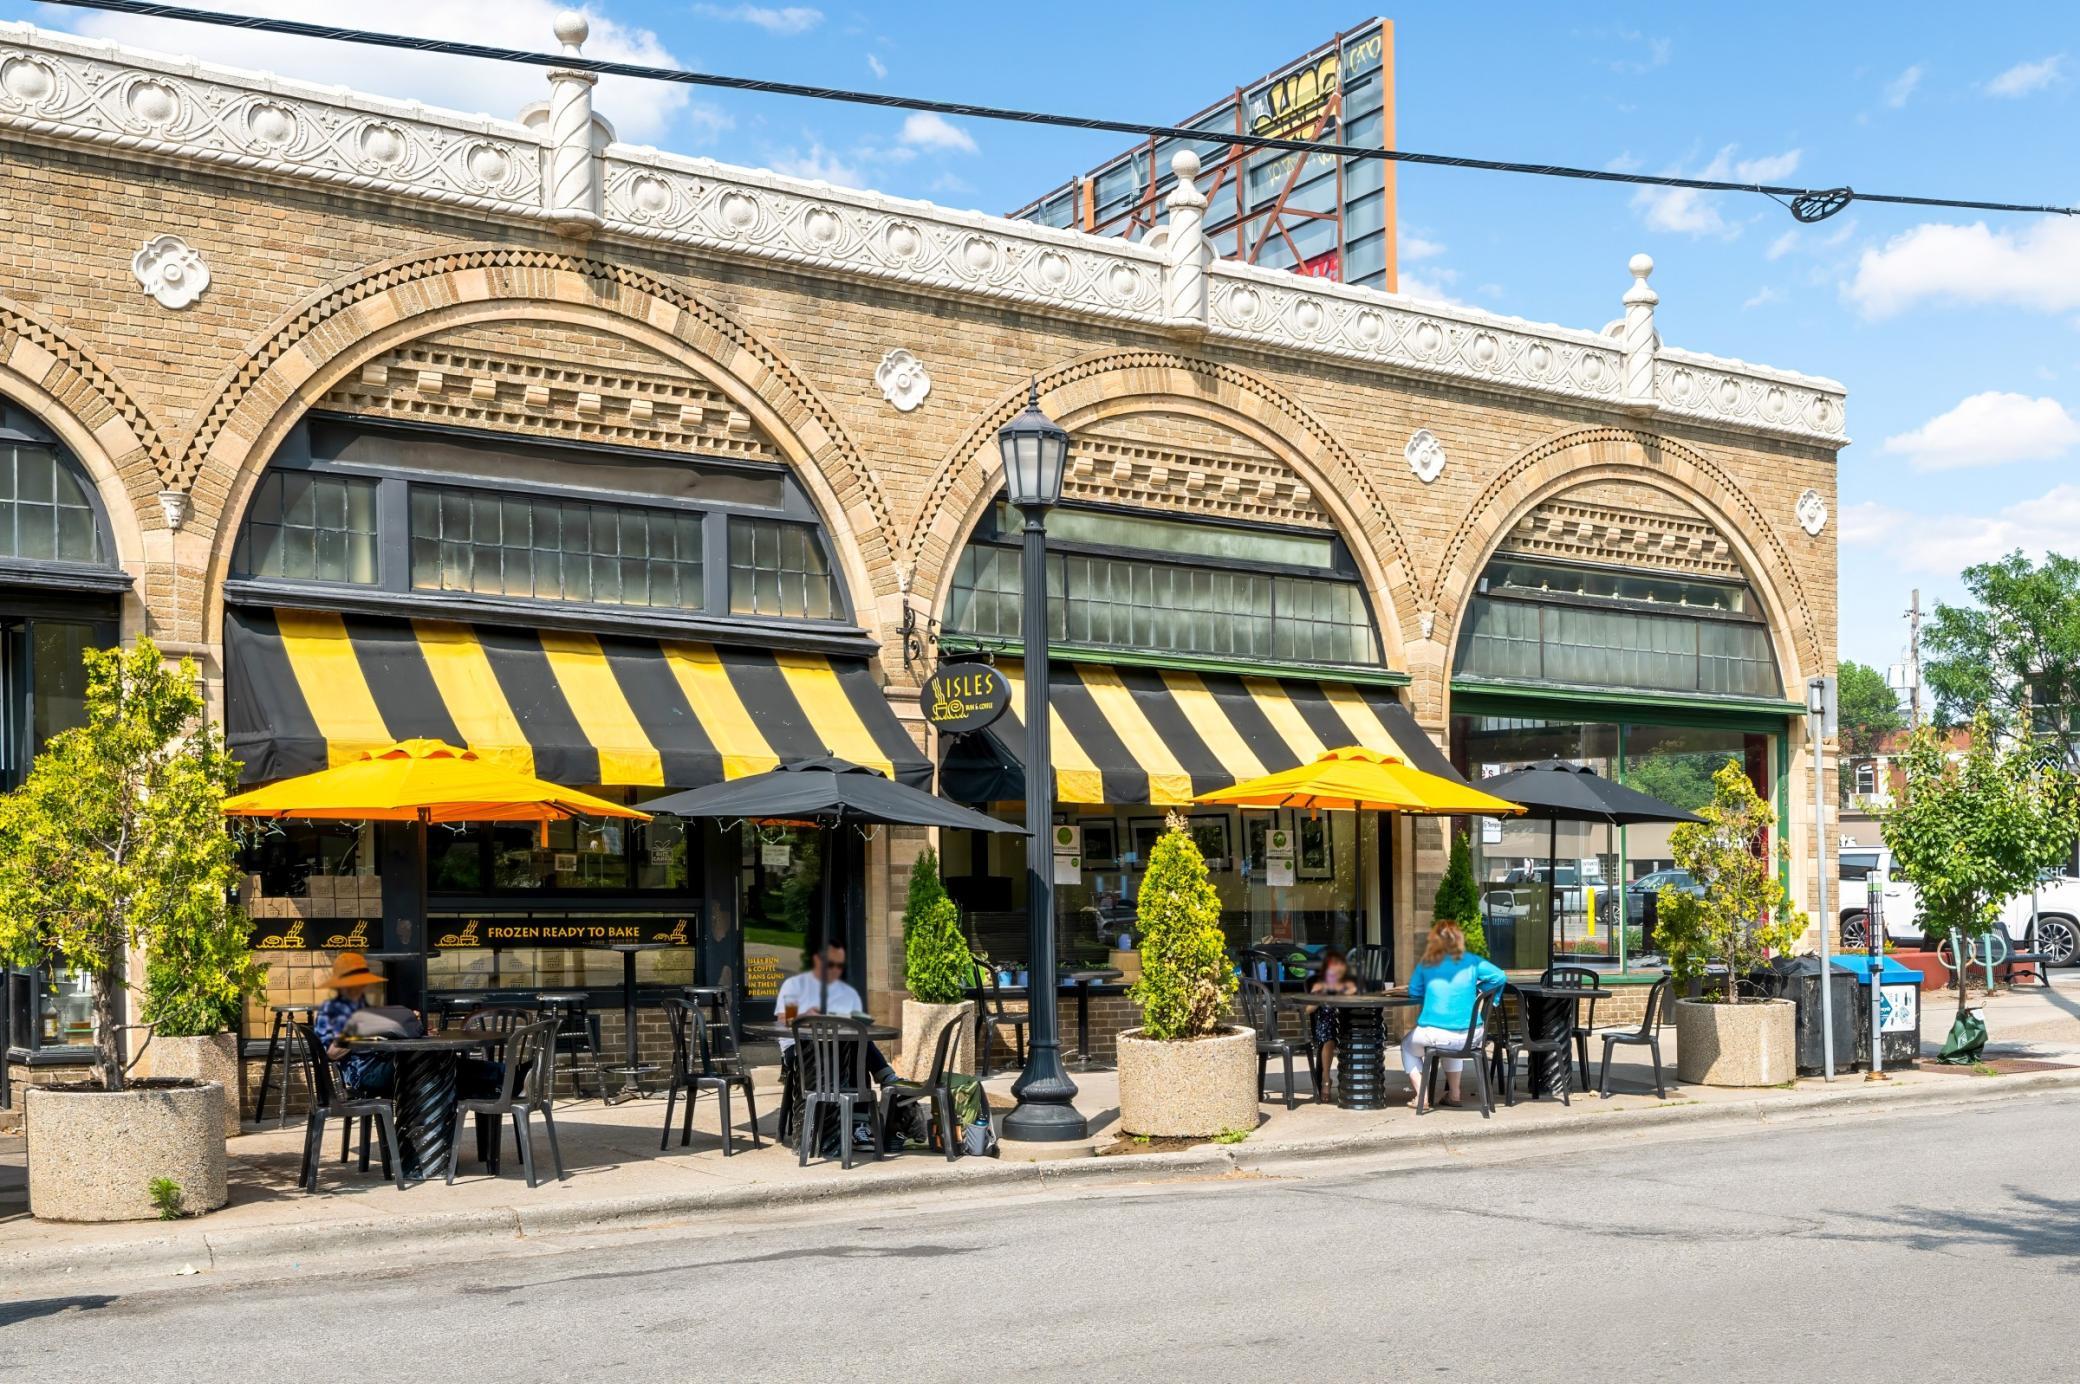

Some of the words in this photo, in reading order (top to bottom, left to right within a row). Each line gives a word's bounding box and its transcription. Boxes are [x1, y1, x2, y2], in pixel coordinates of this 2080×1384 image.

[946, 673, 994, 698] ISLES
[488, 927, 539, 938] FROZEN
[543, 927, 585, 938] READY
[585, 927, 605, 937] TO
[608, 927, 640, 937] BAKE
[766, 972, 785, 980] GUNS
